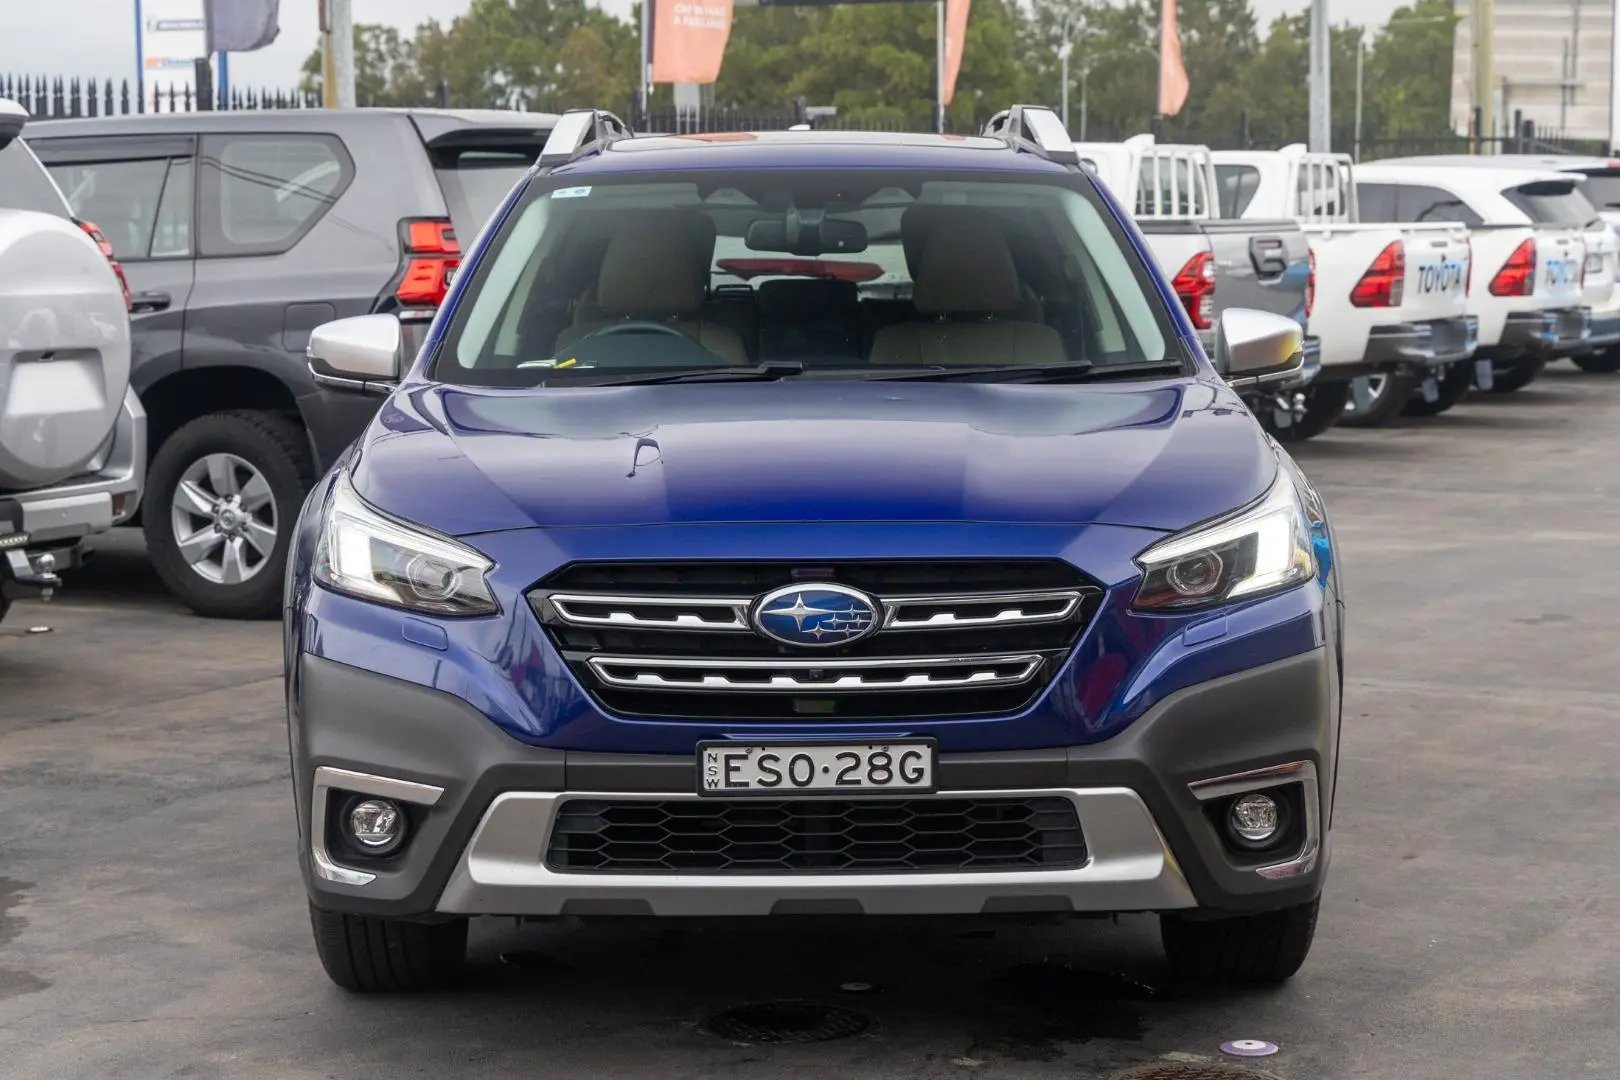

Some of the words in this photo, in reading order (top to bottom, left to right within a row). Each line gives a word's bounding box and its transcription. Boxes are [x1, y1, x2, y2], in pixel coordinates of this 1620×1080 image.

[674, 4, 691, 14] OH
[673, 16, 682, 25] A
[1418, 264, 1460, 293] TOYOTA
[706, 752, 720, 788] NSW
